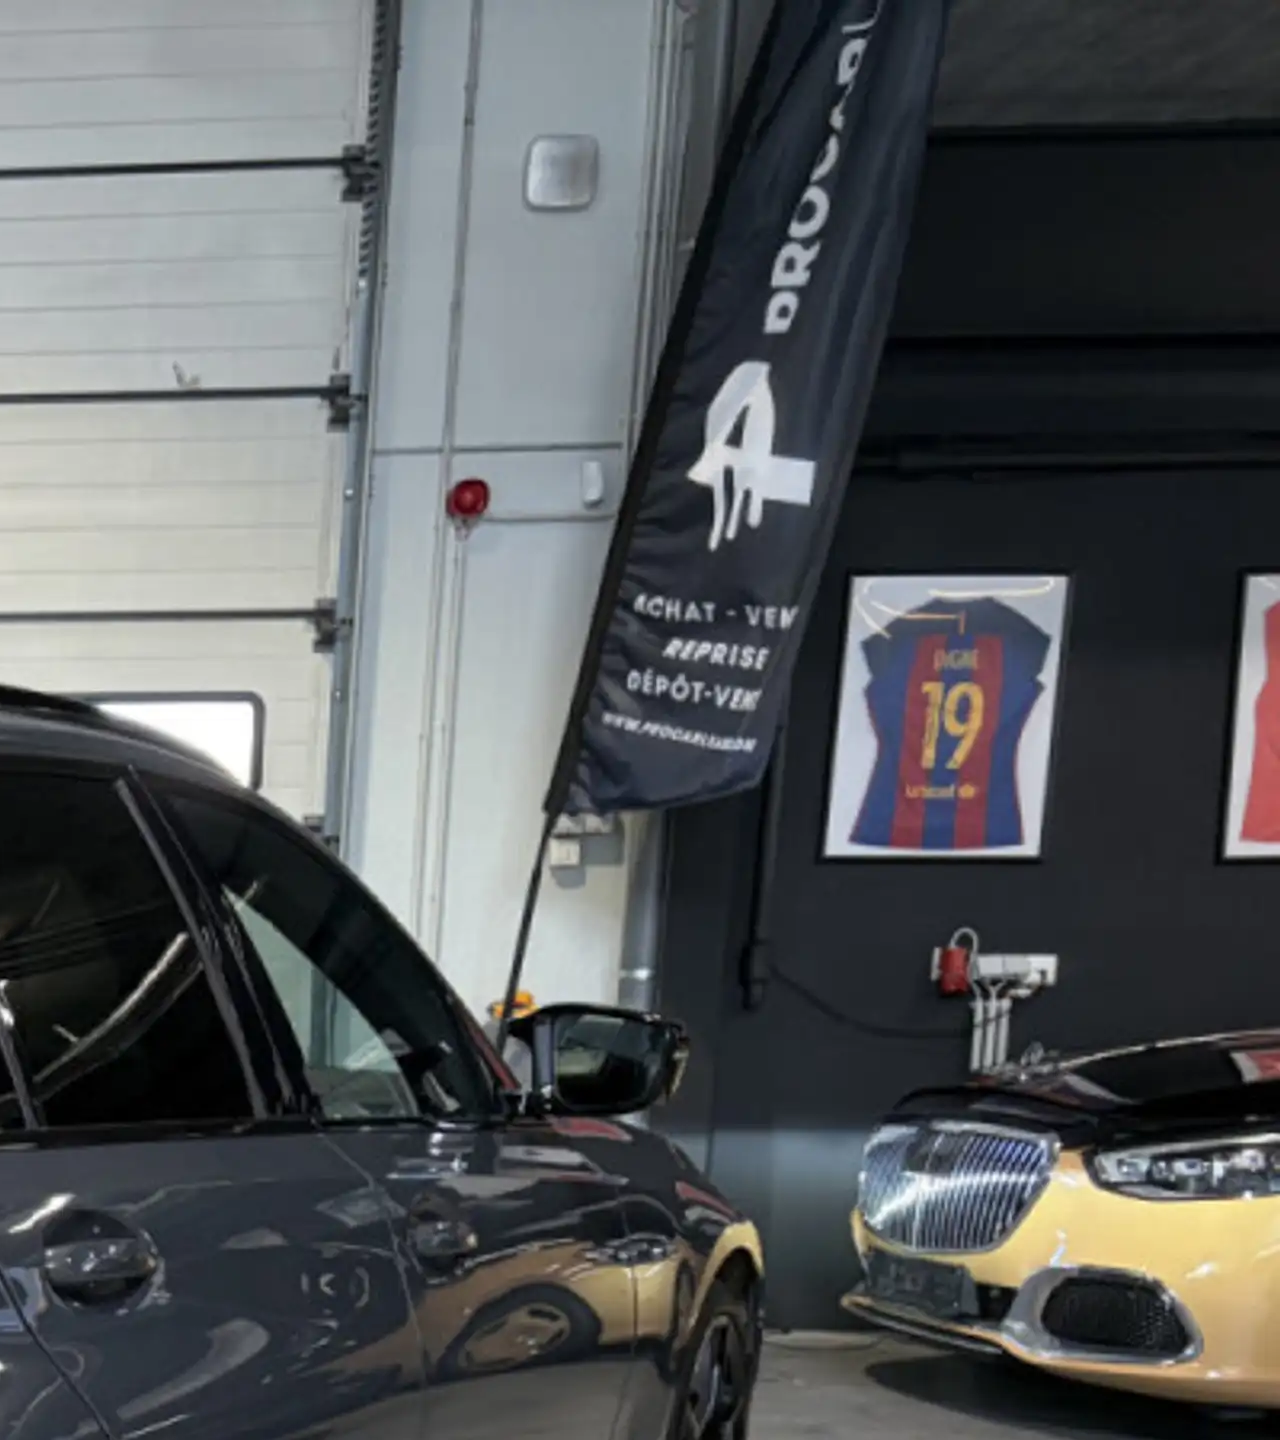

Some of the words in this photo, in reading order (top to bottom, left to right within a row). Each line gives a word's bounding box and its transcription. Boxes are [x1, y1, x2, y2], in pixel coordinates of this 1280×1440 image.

[633, 593, 716, 622] ACHAT
[662, 637, 770, 671] REPRISE
[920, 681, 985, 769] 19
